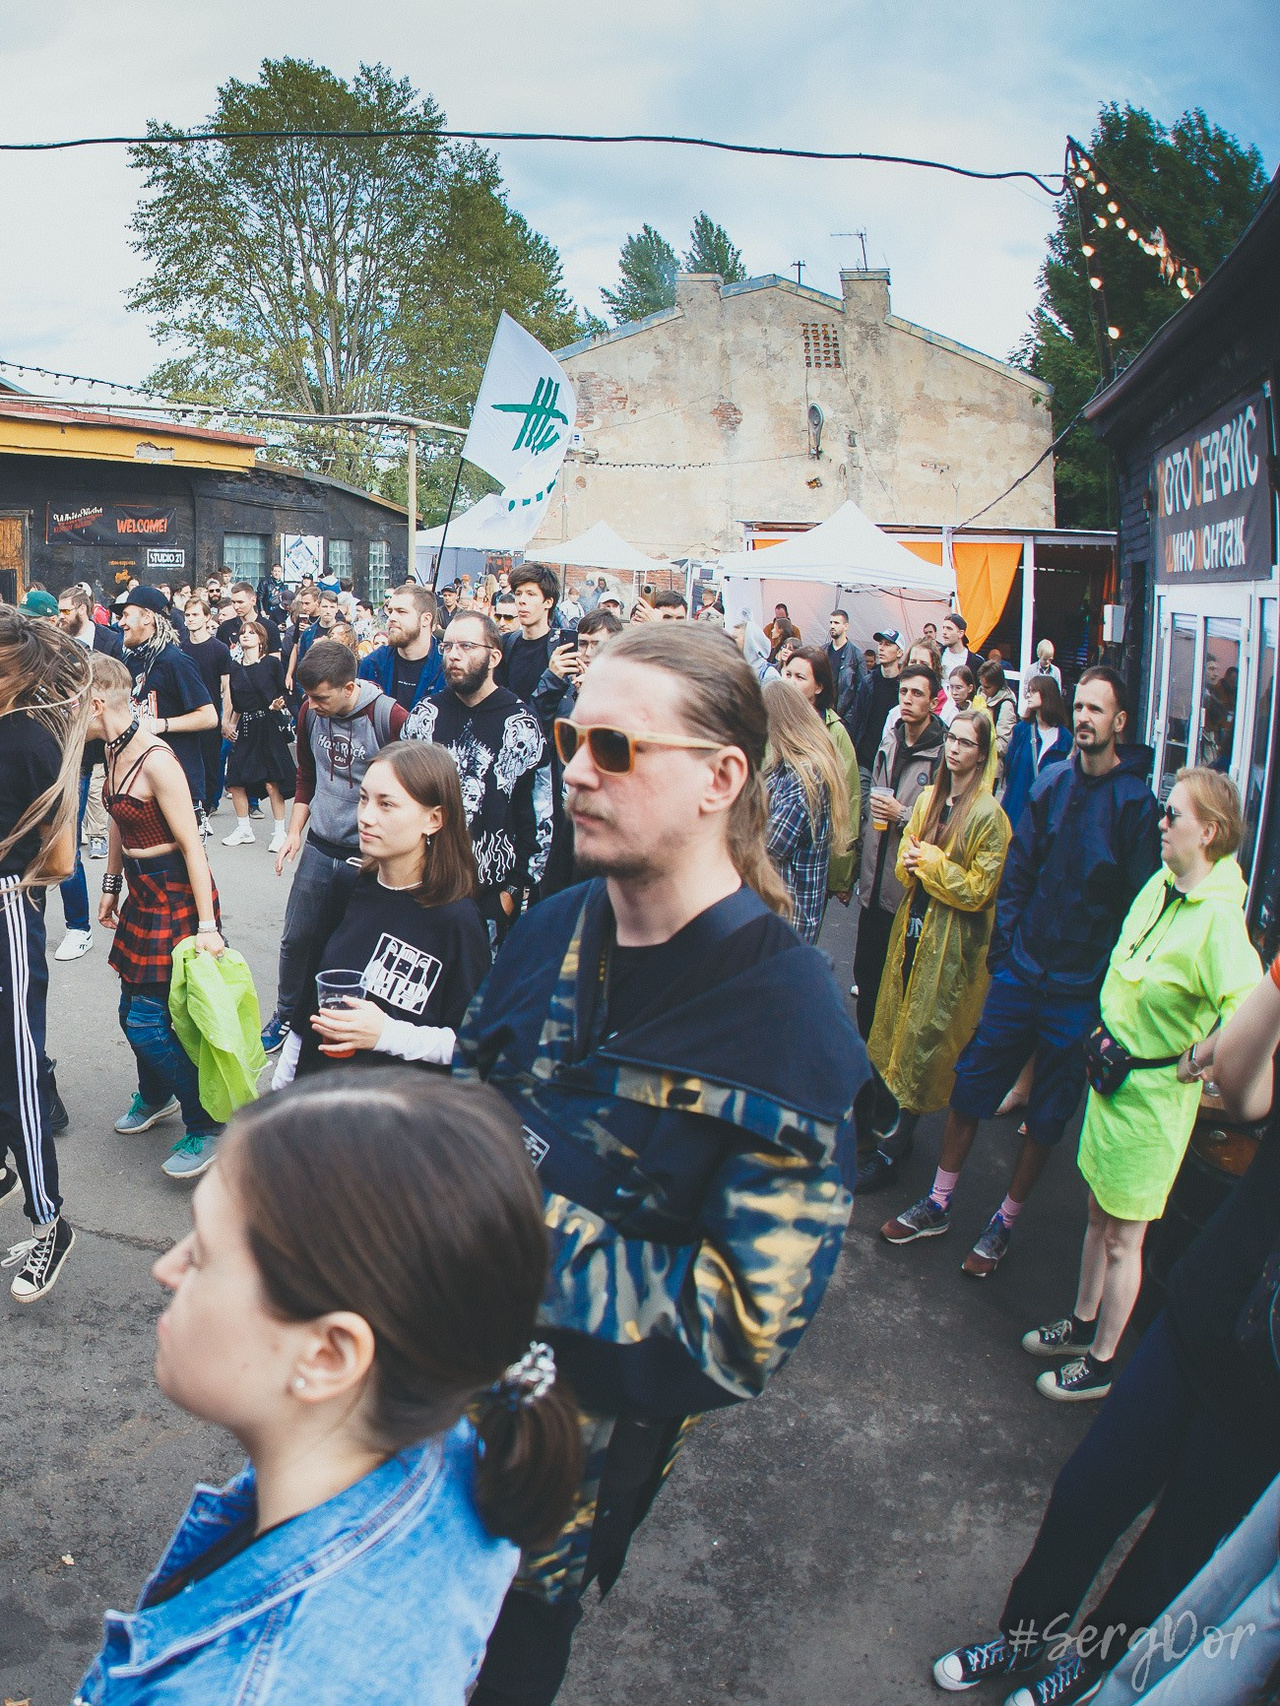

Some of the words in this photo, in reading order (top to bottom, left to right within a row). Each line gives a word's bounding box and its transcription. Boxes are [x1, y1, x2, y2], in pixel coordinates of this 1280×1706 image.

[116, 518, 168, 533] WELCOME!
[150, 552, 175, 563] STUDIO
[175, 553, 182, 563] 21
